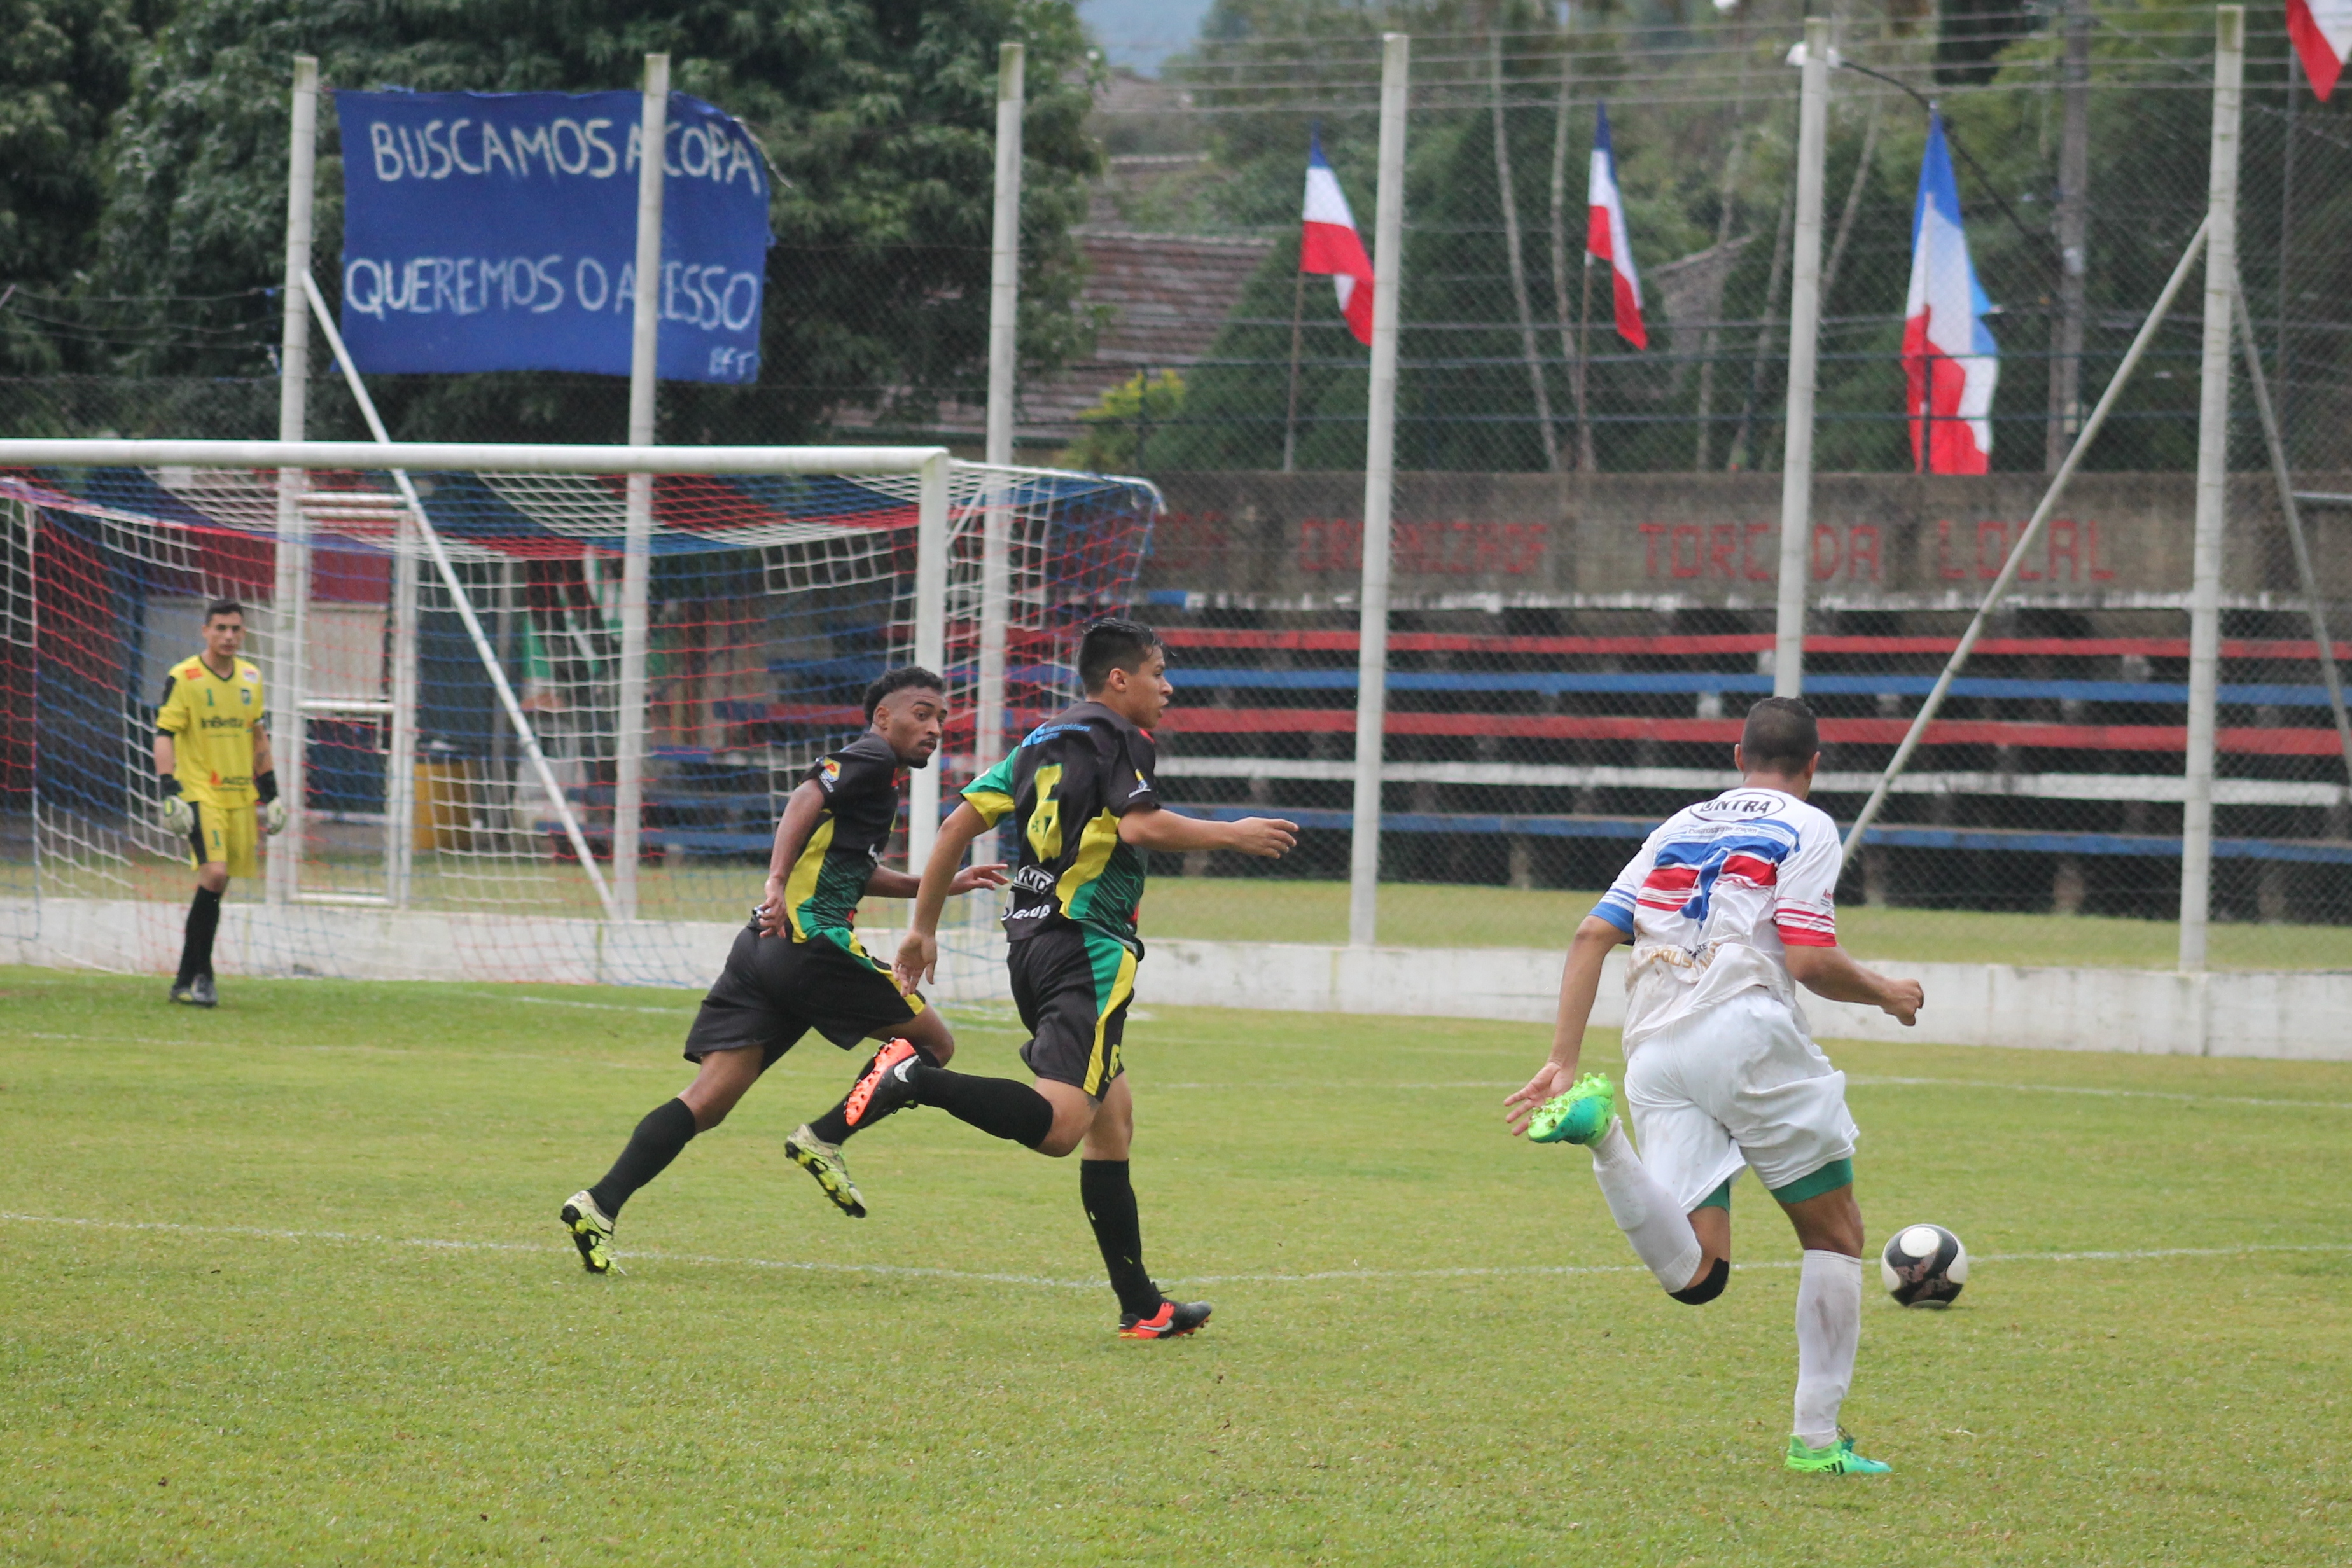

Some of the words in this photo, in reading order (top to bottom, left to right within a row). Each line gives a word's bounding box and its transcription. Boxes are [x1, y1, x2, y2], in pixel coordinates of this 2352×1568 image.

[370, 118, 618, 183] BUSCAMOS
[662, 121, 760, 194] COPA
[345, 255, 563, 321] QUEREMOS
[576, 257, 608, 311] O
[615, 254, 758, 331] AESSO
[1637, 521, 1882, 583] TORCDA
[1027, 763, 1064, 863] 6
[1108, 1043, 1120, 1078] 6
